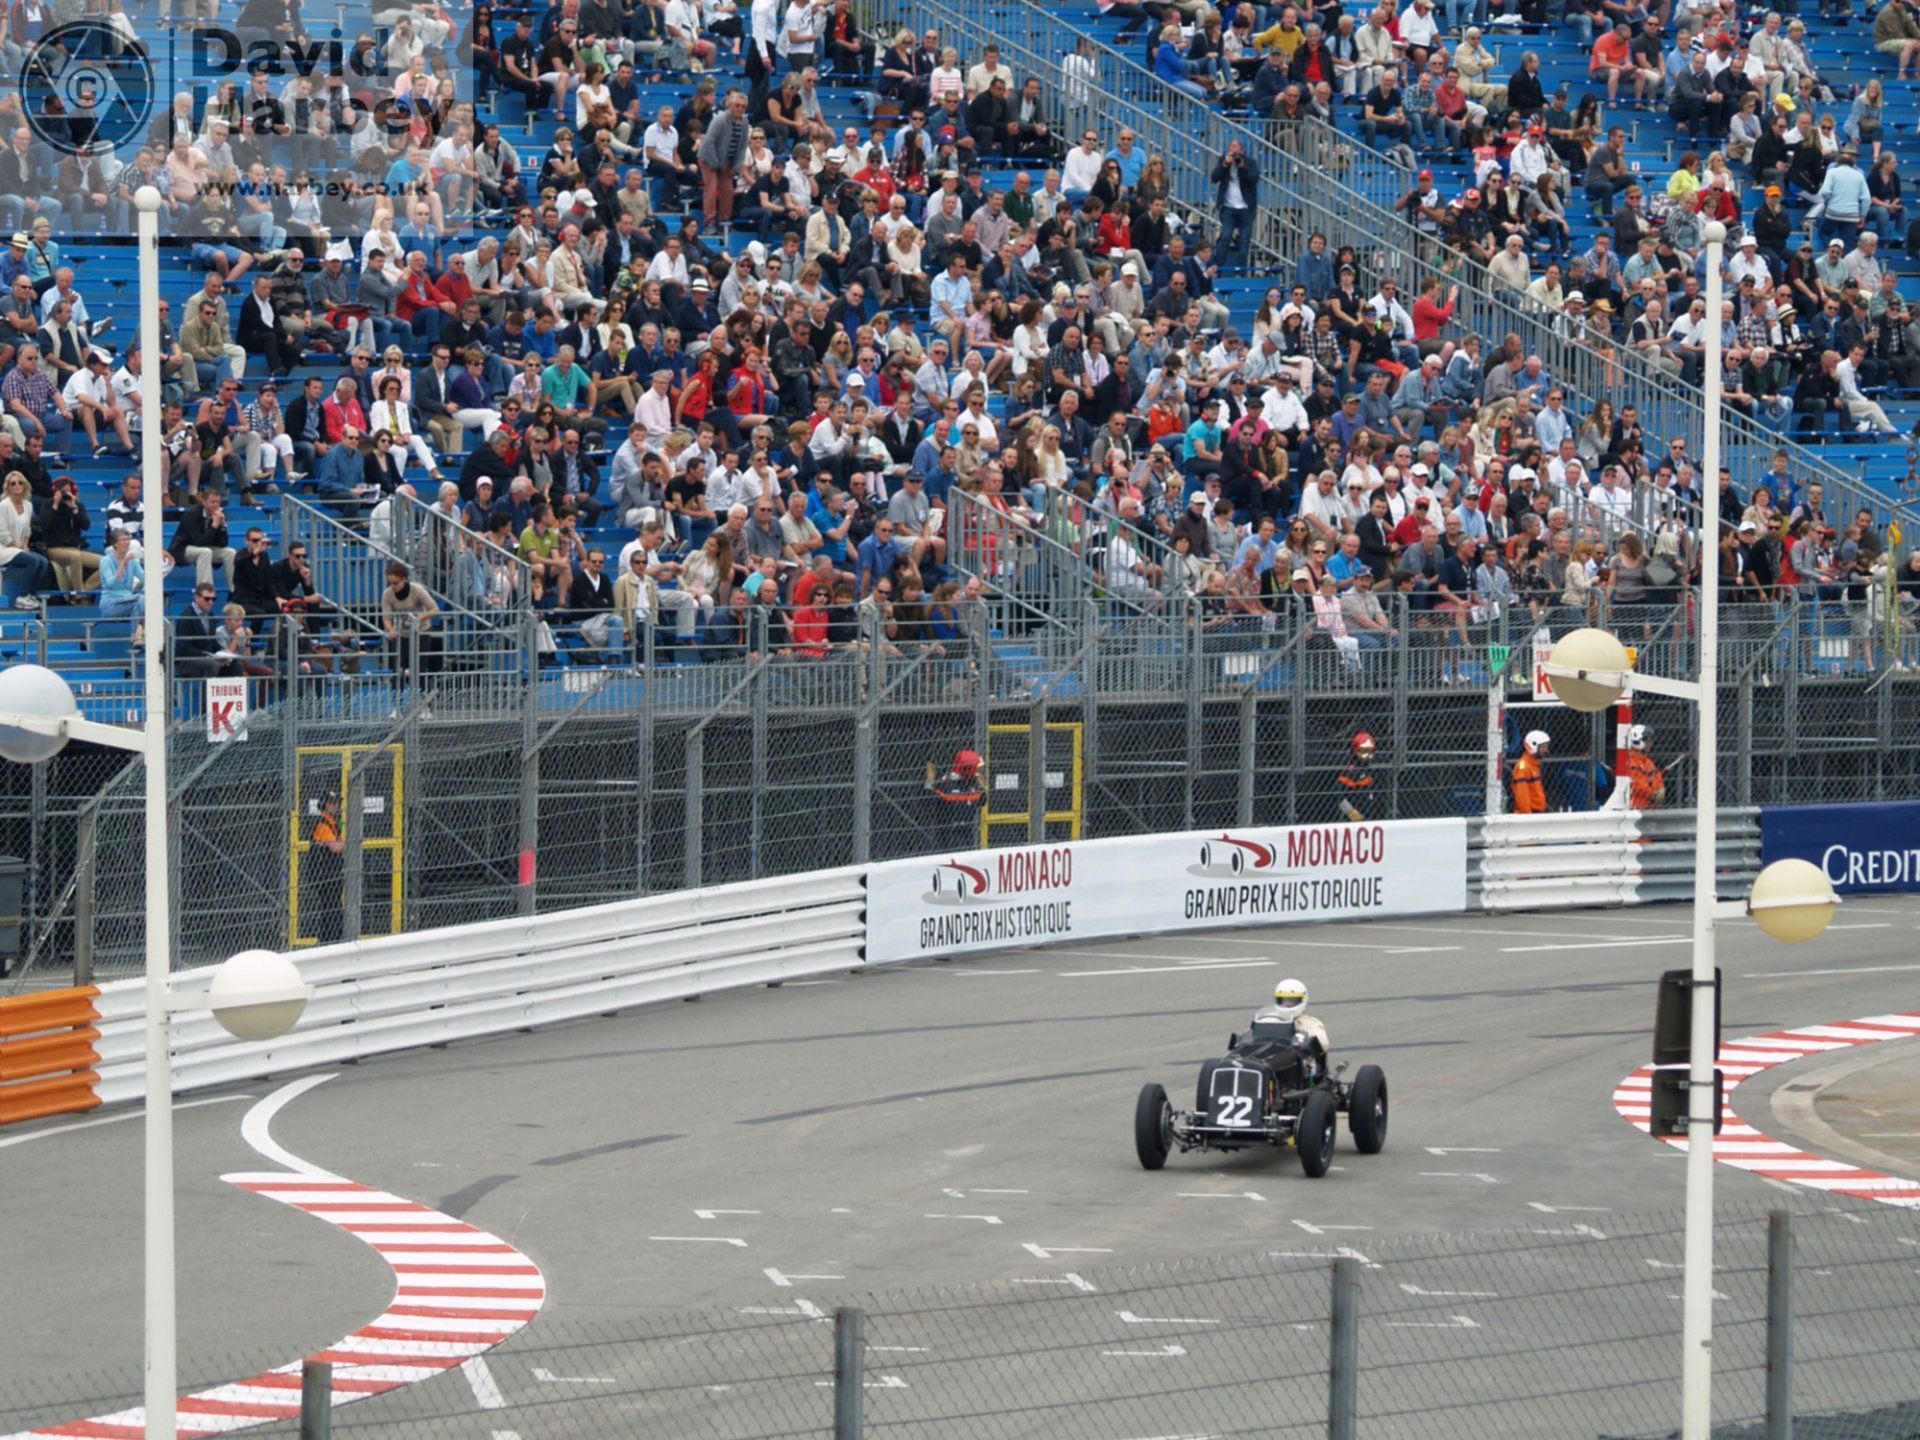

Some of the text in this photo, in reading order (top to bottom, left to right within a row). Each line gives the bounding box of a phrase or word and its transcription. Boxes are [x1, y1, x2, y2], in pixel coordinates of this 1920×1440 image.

[211, 684, 243, 697] TRIBUNE
[1287, 826, 1384, 868] MONACO
[998, 848, 1072, 895] MONACO
[1217, 1095, 1253, 1127] 22
